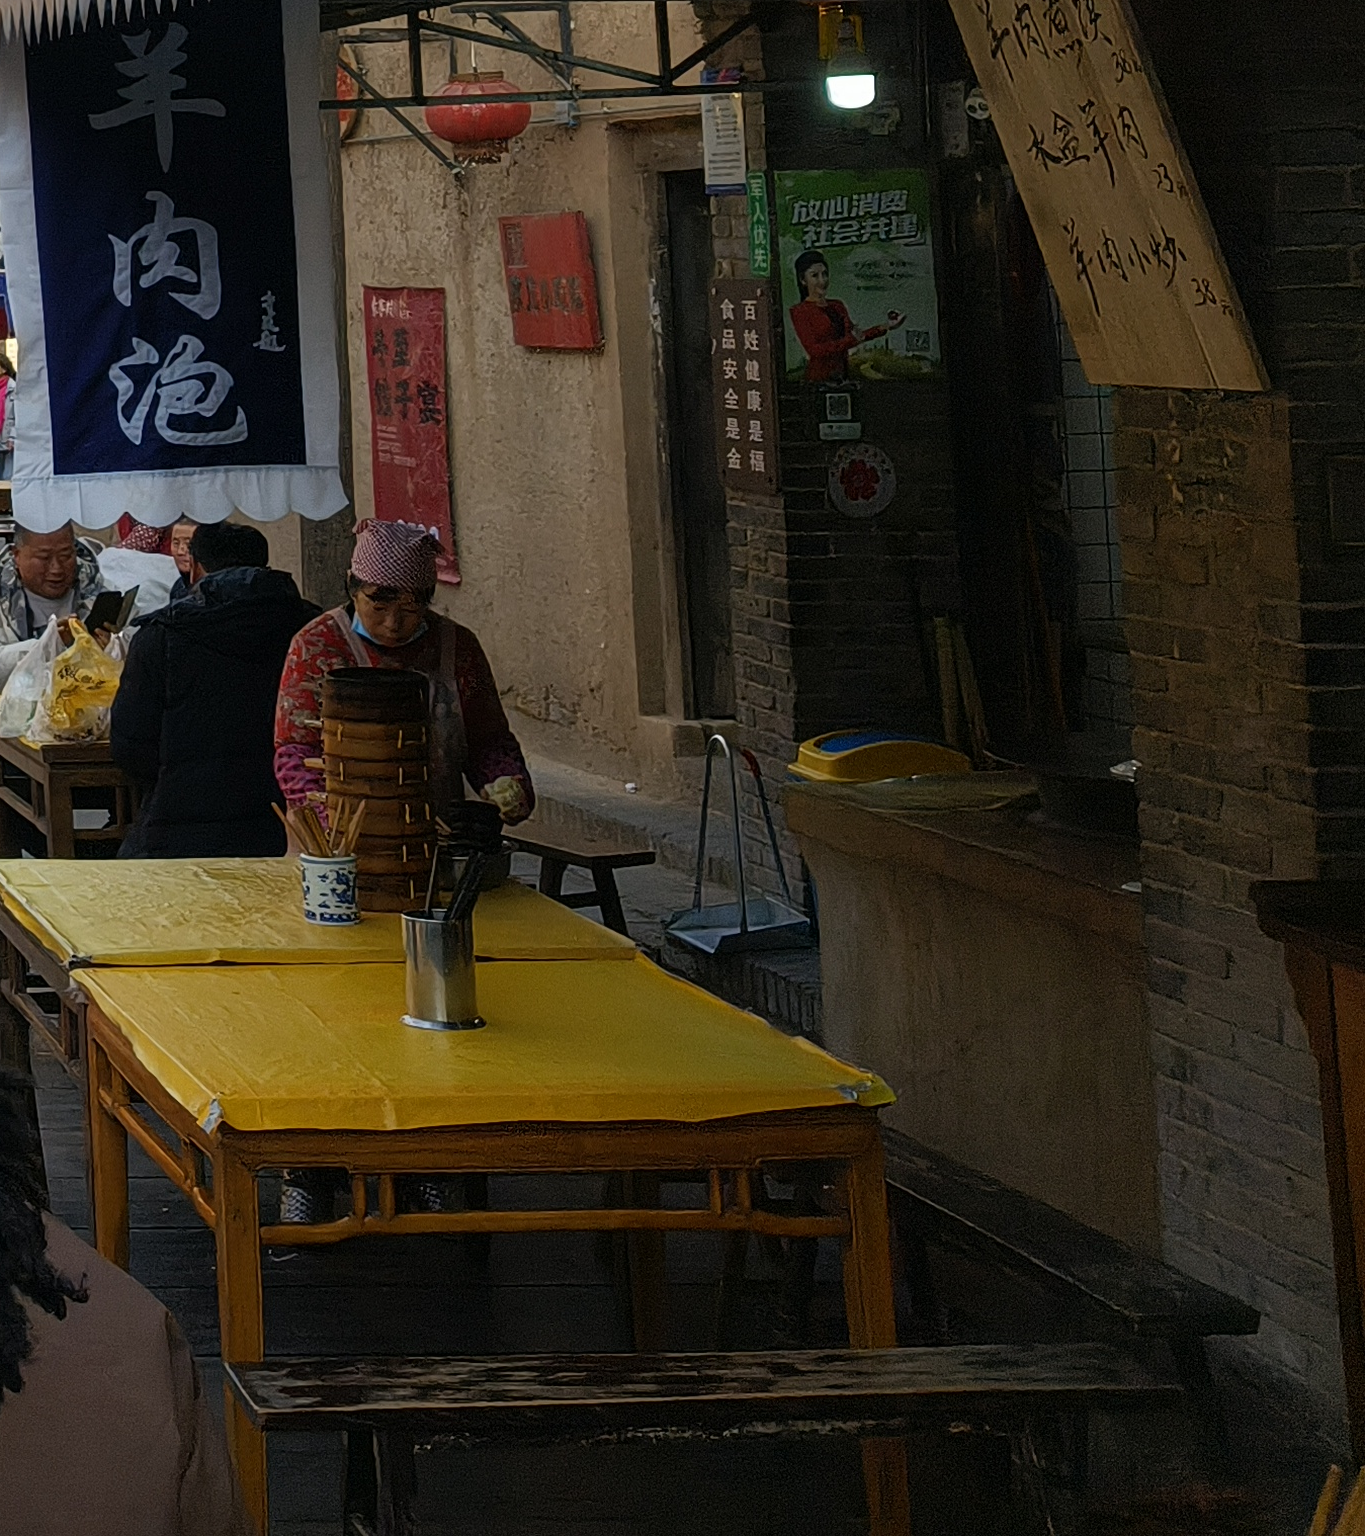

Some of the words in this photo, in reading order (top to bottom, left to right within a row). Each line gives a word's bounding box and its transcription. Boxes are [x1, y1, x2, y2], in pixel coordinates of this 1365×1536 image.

[88, 21, 248, 447] 羊肉泡
[749, 179, 767, 268] 军人优先
[791, 190, 909, 224] 放心消费
[720, 298, 742, 470] 食品安全是金
[741, 299, 765, 473] 百姓健康是福
